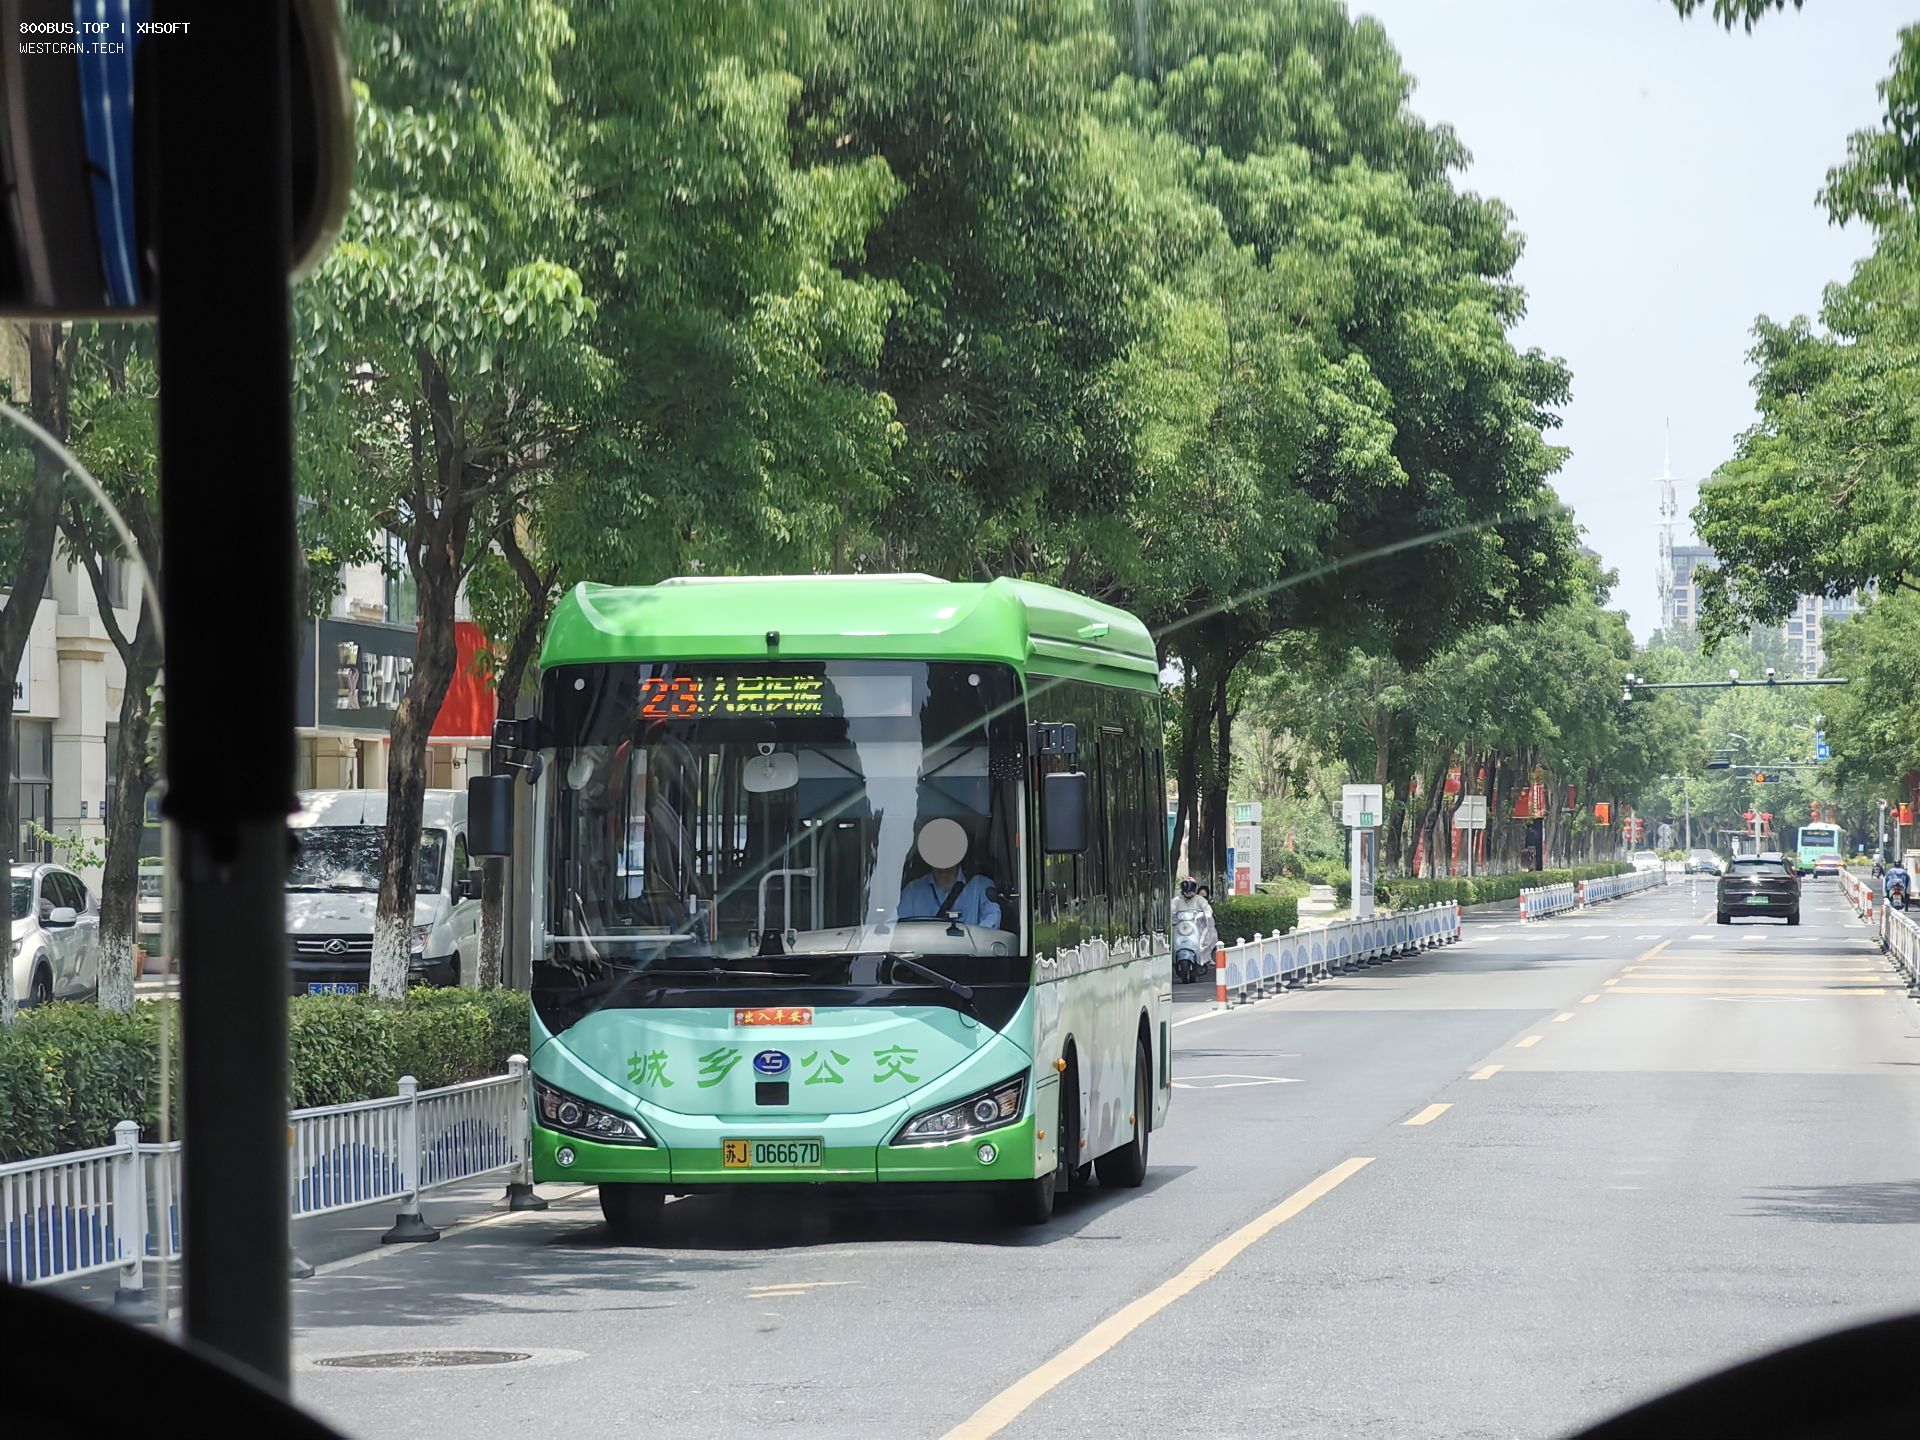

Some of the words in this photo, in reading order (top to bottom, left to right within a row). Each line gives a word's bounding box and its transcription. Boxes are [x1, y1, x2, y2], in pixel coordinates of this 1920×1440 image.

[641, 677, 698, 717] 23
[698, 675, 823, 717] 人民医院
[744, 1009, 802, 1024] 出入平安
[626, 1044, 920, 1088] 城乡公交
[755, 1143, 820, 1164] 06667D
